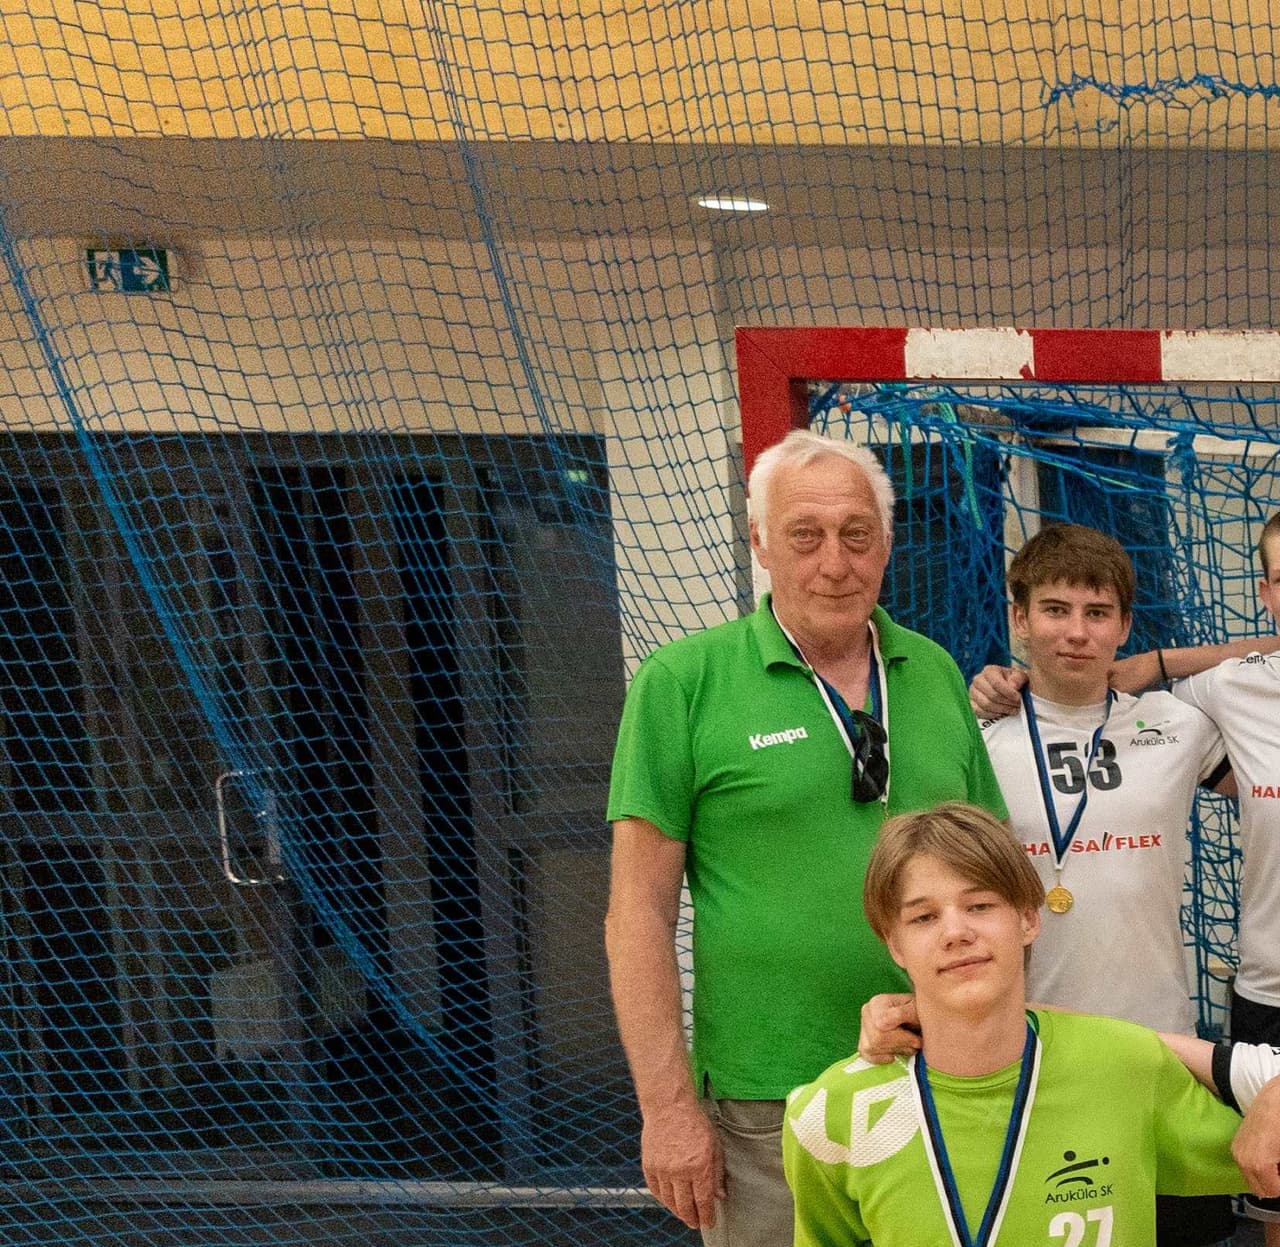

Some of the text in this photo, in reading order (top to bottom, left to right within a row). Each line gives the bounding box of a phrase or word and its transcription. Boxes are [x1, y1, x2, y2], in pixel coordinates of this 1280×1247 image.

[749, 726, 808, 751] Kempa
[1130, 735, 1180, 747] Aruküla SK
[1046, 738, 1122, 795] 53
[1023, 833, 1162, 856] HASA FLEX
[1045, 1183, 1114, 1204] Aruküla SK
